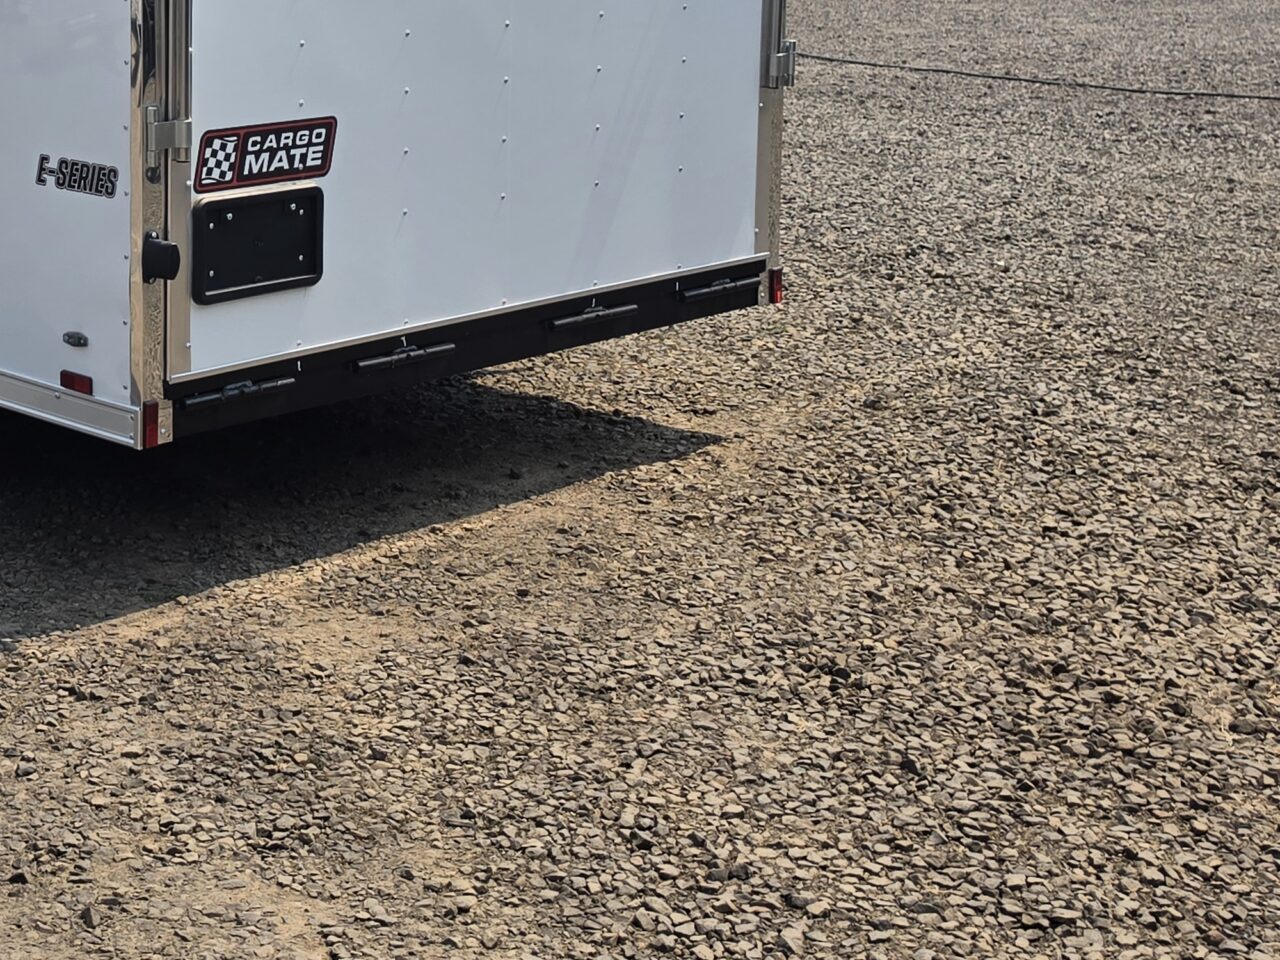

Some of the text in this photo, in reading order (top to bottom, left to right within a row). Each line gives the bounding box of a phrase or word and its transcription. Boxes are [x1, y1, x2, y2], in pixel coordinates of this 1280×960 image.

[247, 128, 327, 152] CARGO
[35, 153, 119, 199] E-SERIES
[243, 145, 324, 176] MATE
